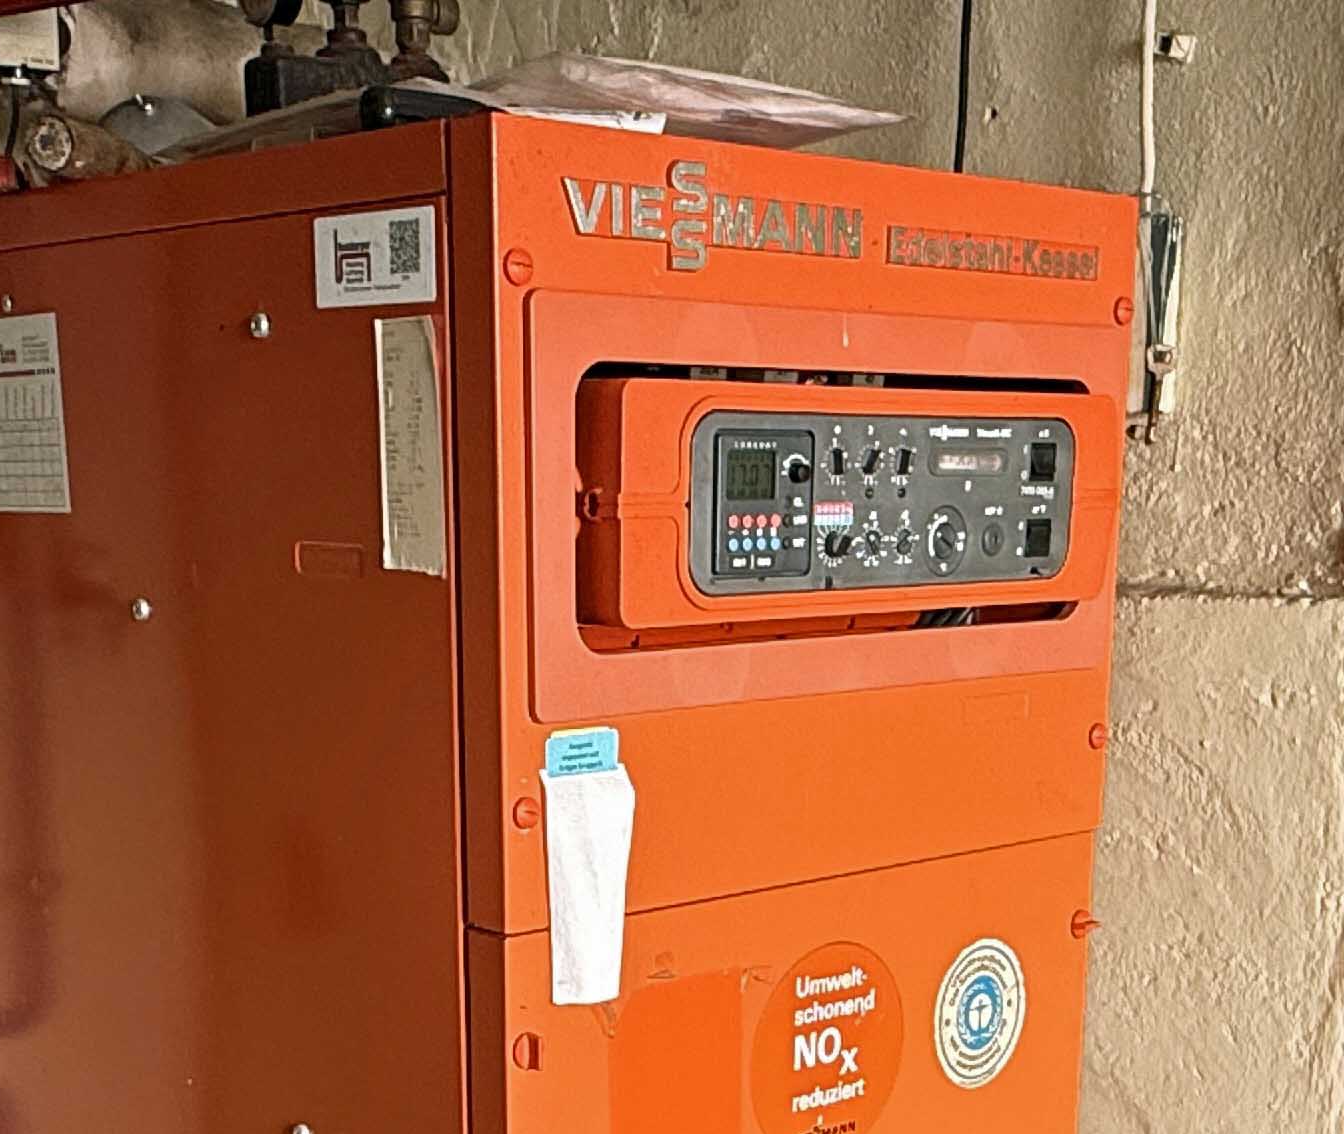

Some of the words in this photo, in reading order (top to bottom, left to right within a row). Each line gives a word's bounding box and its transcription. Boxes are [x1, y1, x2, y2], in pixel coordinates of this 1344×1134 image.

[562, 160, 862, 272] VIESSMANN
[795, 966, 868, 999] Umwelt-
[793, 988, 876, 1027] schonend
[791, 1078, 866, 1113] reduziert
